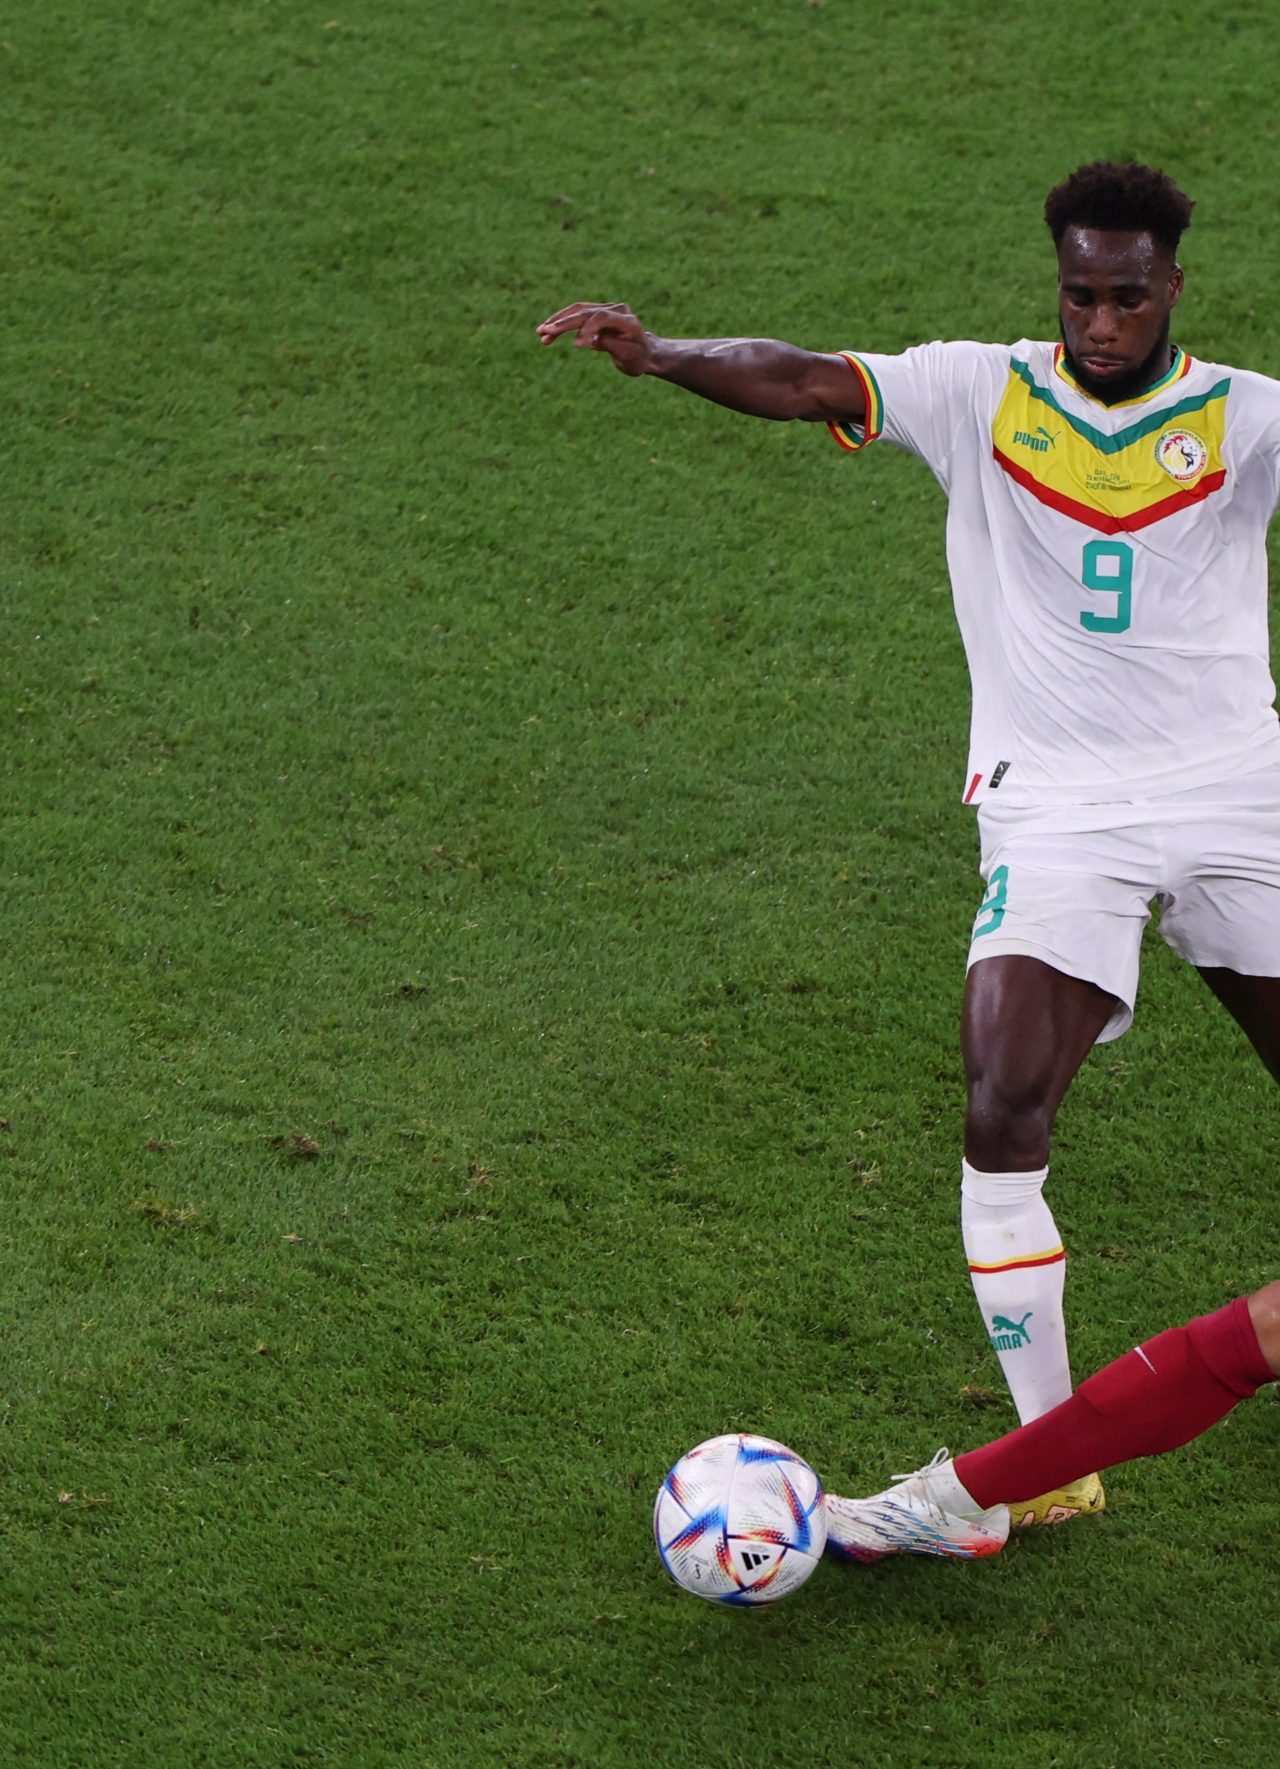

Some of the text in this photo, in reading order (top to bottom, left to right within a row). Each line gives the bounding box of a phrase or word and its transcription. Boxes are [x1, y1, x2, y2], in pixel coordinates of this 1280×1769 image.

[1013, 431, 1049, 452] PUMA
[1080, 539, 1133, 634] 9
[991, 1333, 1022, 1351] MA
